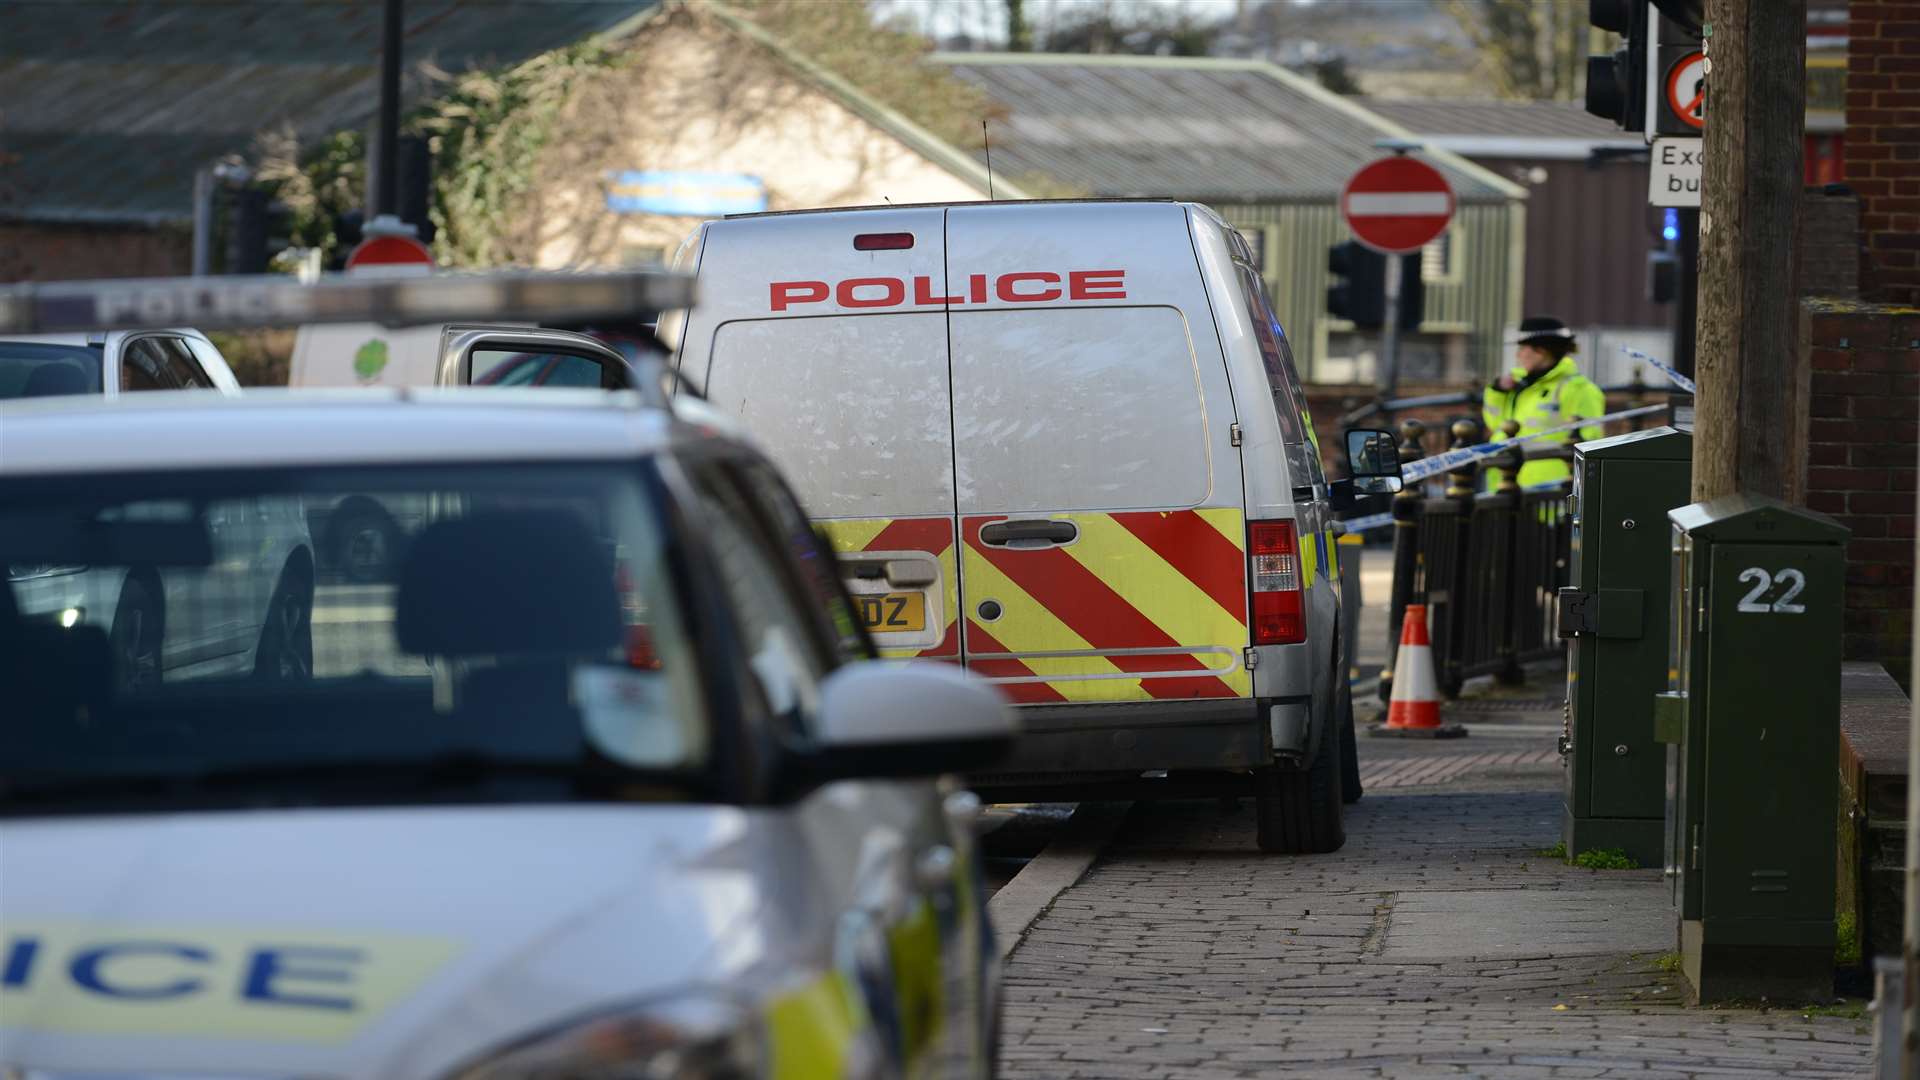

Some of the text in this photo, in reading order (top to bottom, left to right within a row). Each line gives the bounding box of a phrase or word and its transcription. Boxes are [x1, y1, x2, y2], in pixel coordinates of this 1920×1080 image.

[1668, 174, 1699, 192] bu
[98, 284, 312, 325] POLIC
[770, 270, 1127, 312] POLICE
[1737, 567, 1806, 613] 22
[0, 938, 370, 1013] ICE
